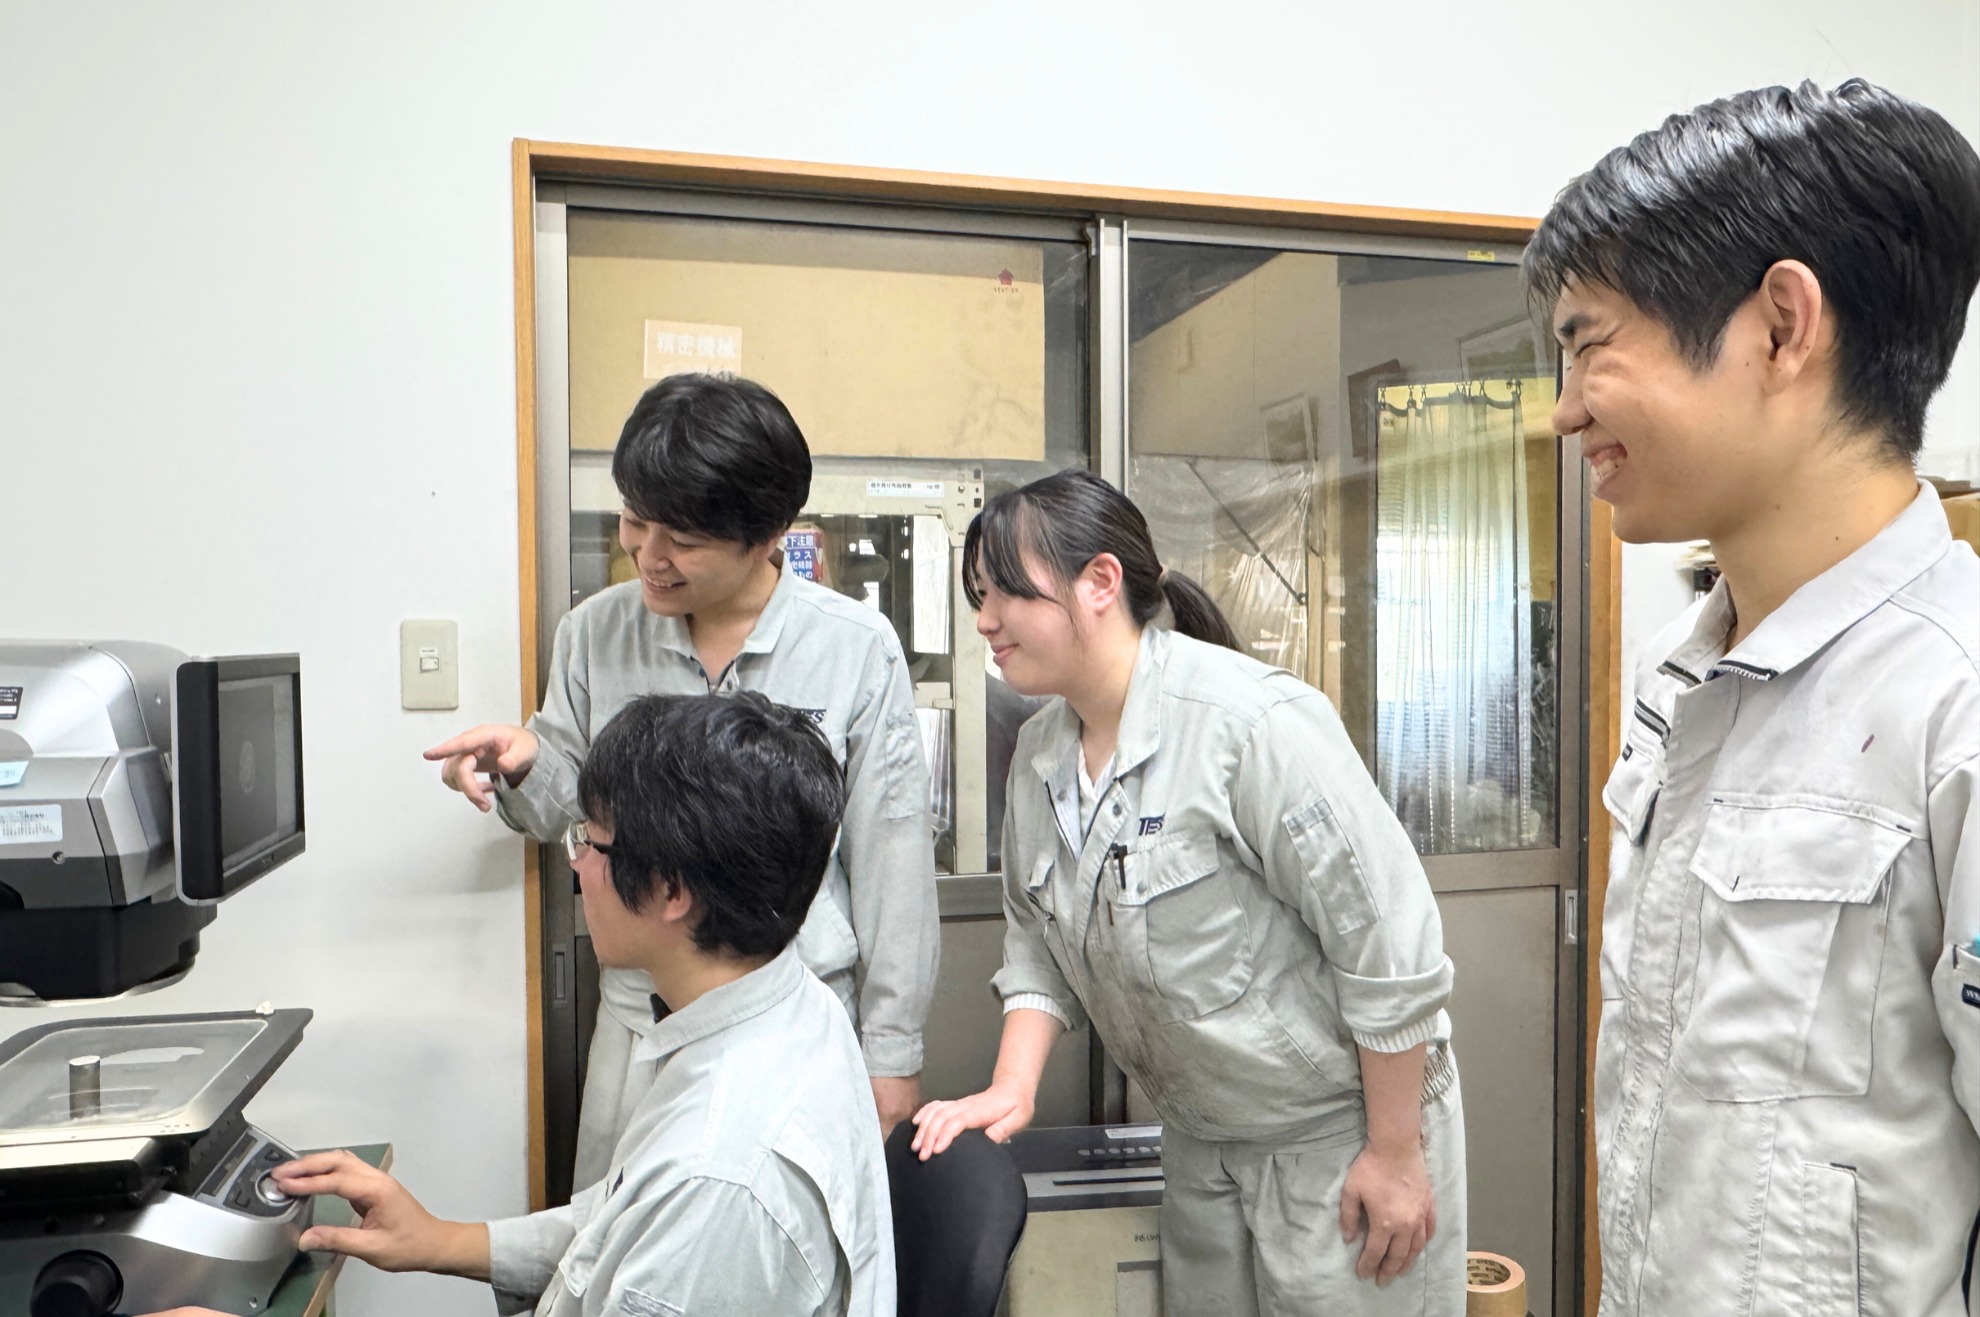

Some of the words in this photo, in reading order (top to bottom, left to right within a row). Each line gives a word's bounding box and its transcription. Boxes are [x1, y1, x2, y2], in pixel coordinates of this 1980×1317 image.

[786, 535, 814, 547] 下注意
[1138, 813, 1166, 836] TES
